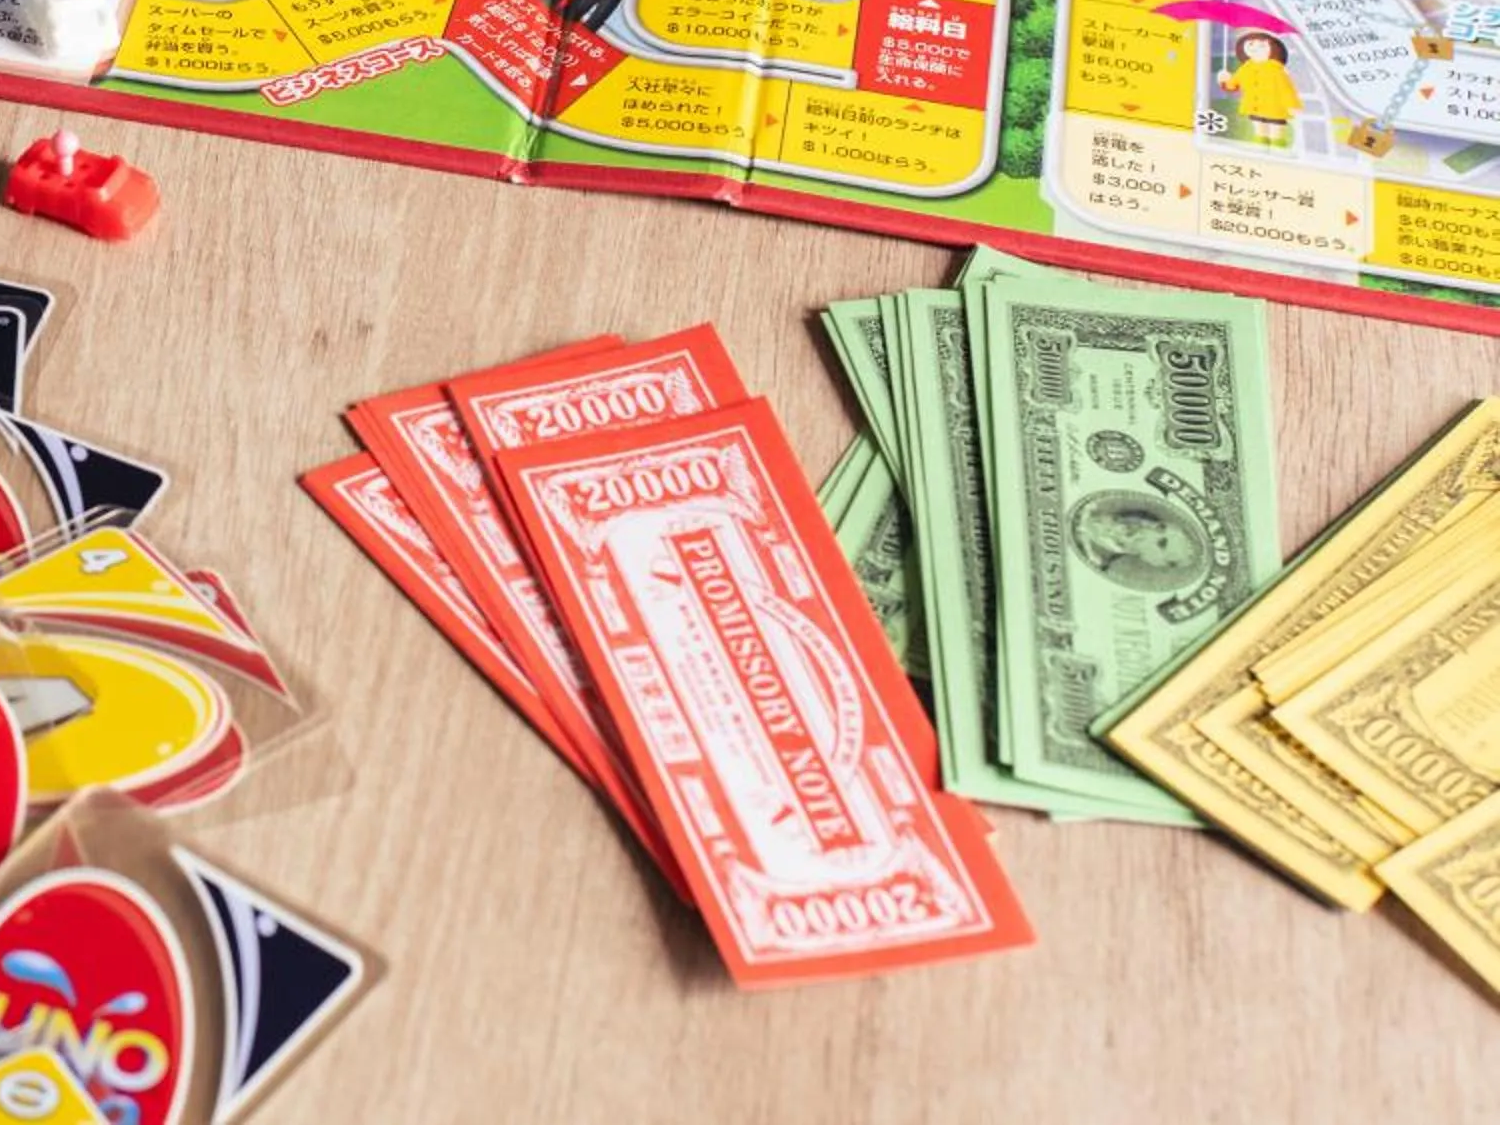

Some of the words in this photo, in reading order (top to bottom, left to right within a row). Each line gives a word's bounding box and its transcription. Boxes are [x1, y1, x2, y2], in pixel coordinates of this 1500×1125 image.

[262, 37, 443, 105] ビジネスコース
[1091, 172, 1167, 196] $3,000
[530, 382, 666, 438] 20000
[1168, 345, 1219, 450] 50000
[581, 457, 720, 512] 20000
[1159, 473, 1231, 568] DEMAND
[1164, 574, 1228, 623] NOTE
[680, 538, 803, 745] PROMISSORY
[783, 737, 848, 845] NOTE
[773, 881, 928, 937] 20000
